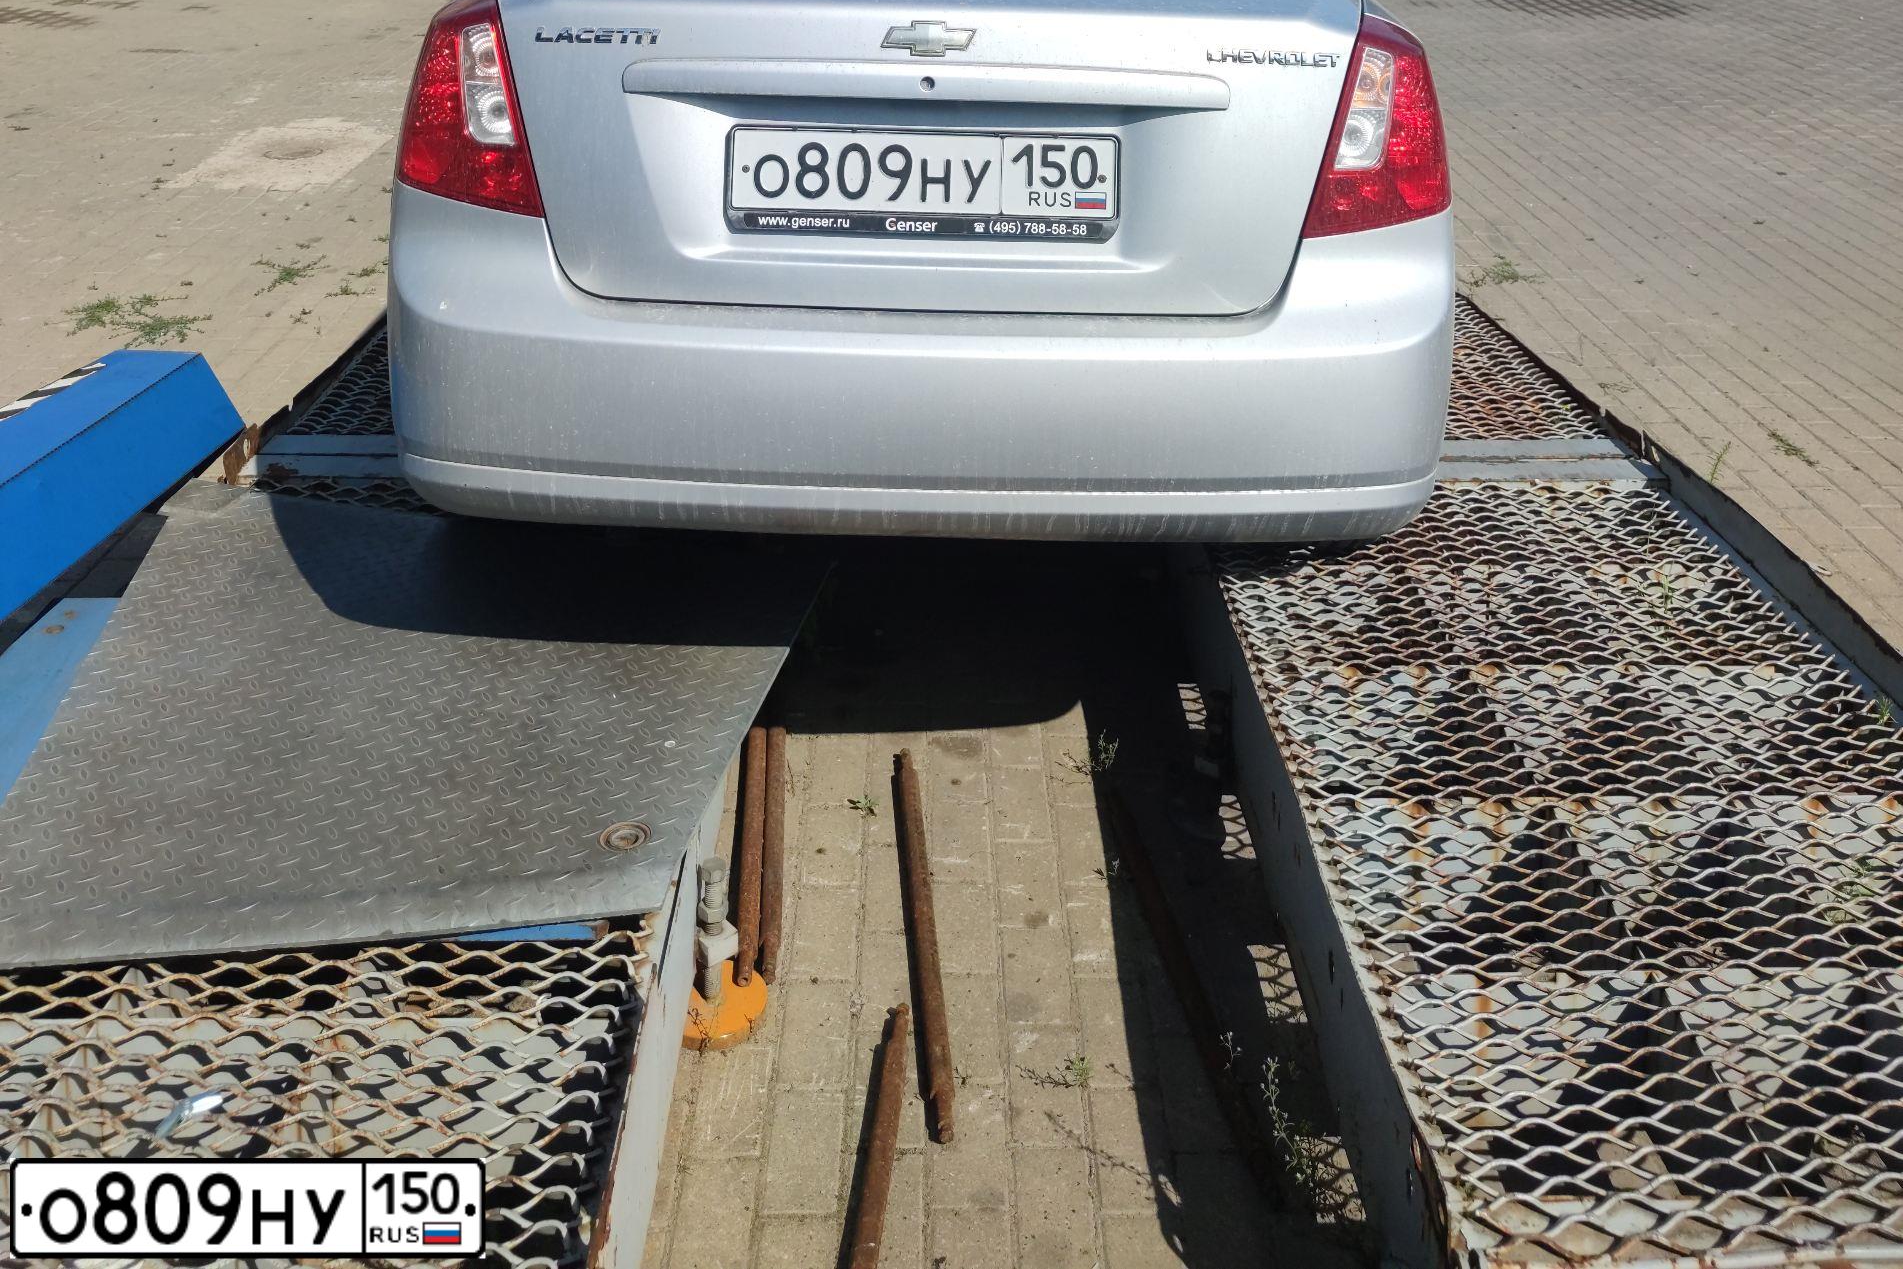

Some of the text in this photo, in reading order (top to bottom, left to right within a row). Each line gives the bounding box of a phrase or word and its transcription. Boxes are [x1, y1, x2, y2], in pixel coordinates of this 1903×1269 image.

[535, 27, 661, 44] LACETTI
[1206, 48, 1341, 68] CHEVROLET
[1011, 143, 1098, 190] 150
[1029, 190, 1072, 209] RUS
[758, 215, 850, 229] www.genser.ru
[885, 217, 938, 232] Genser
[989, 220, 1087, 235] (495) 788-58-58
